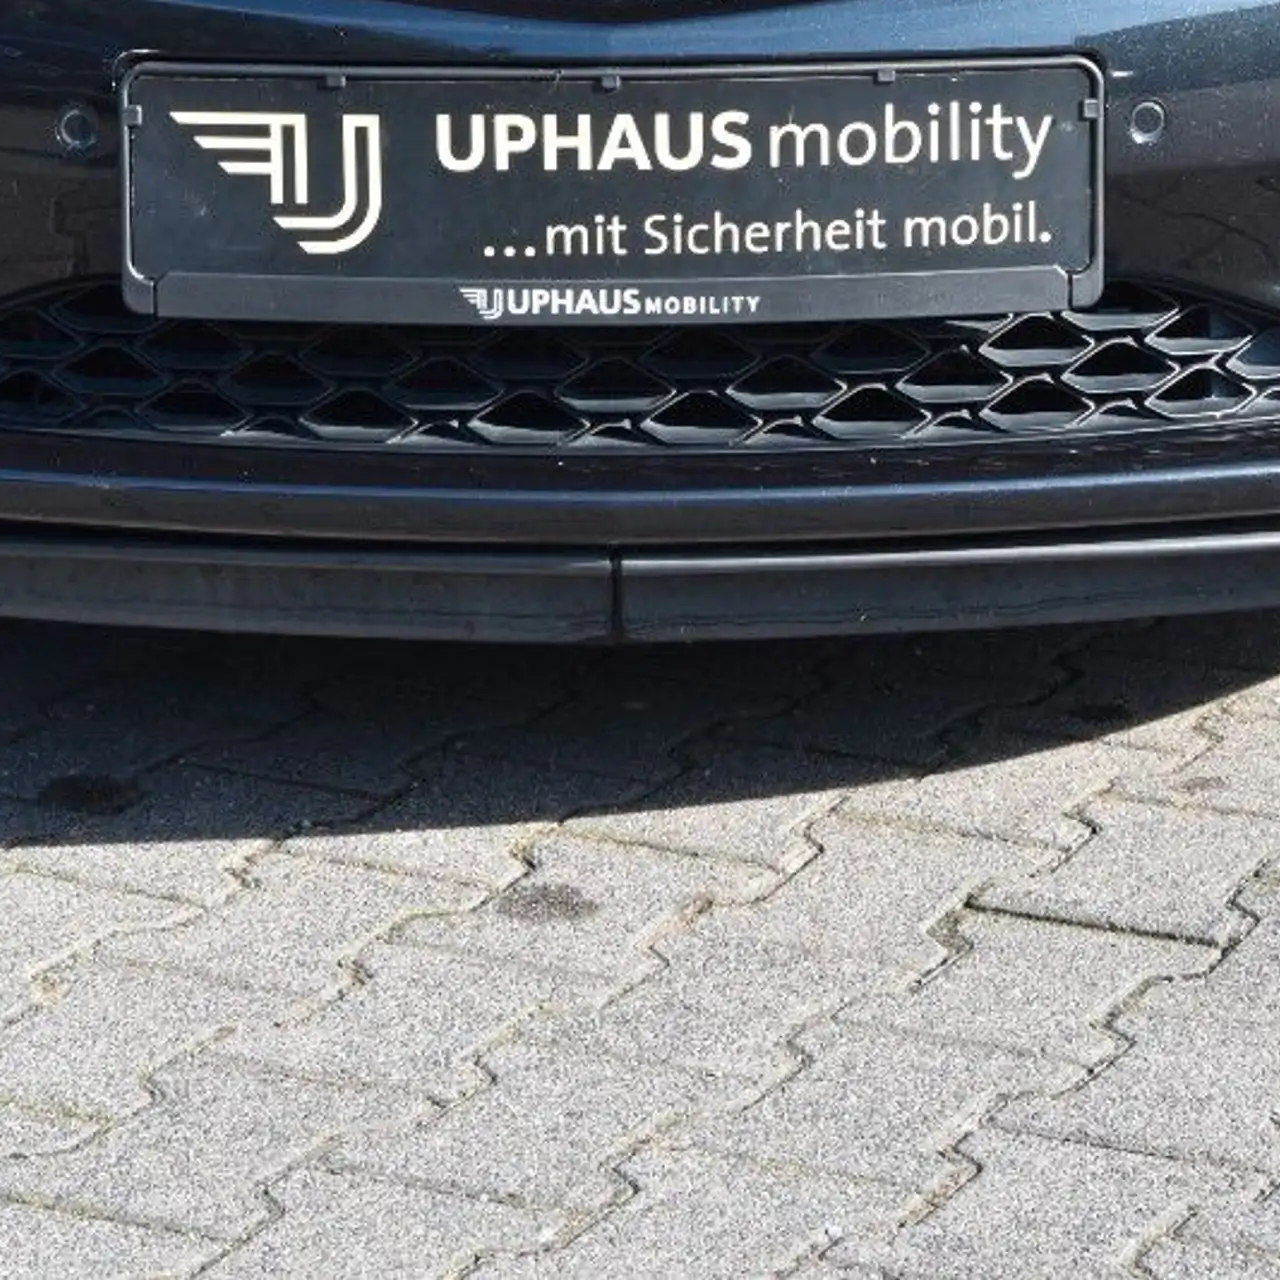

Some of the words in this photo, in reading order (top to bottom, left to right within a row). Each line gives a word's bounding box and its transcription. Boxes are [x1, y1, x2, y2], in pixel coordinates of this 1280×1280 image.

[435, 109, 754, 173] UPHAUS
[768, 99, 1054, 182] mobility
[482, 212, 629, 258] ...mit
[643, 207, 888, 256] Sicherheit
[902, 198, 1053, 249] mobil.
[507, 287, 641, 316] UPHAUS
[644, 295, 762, 315] MOBILITY
